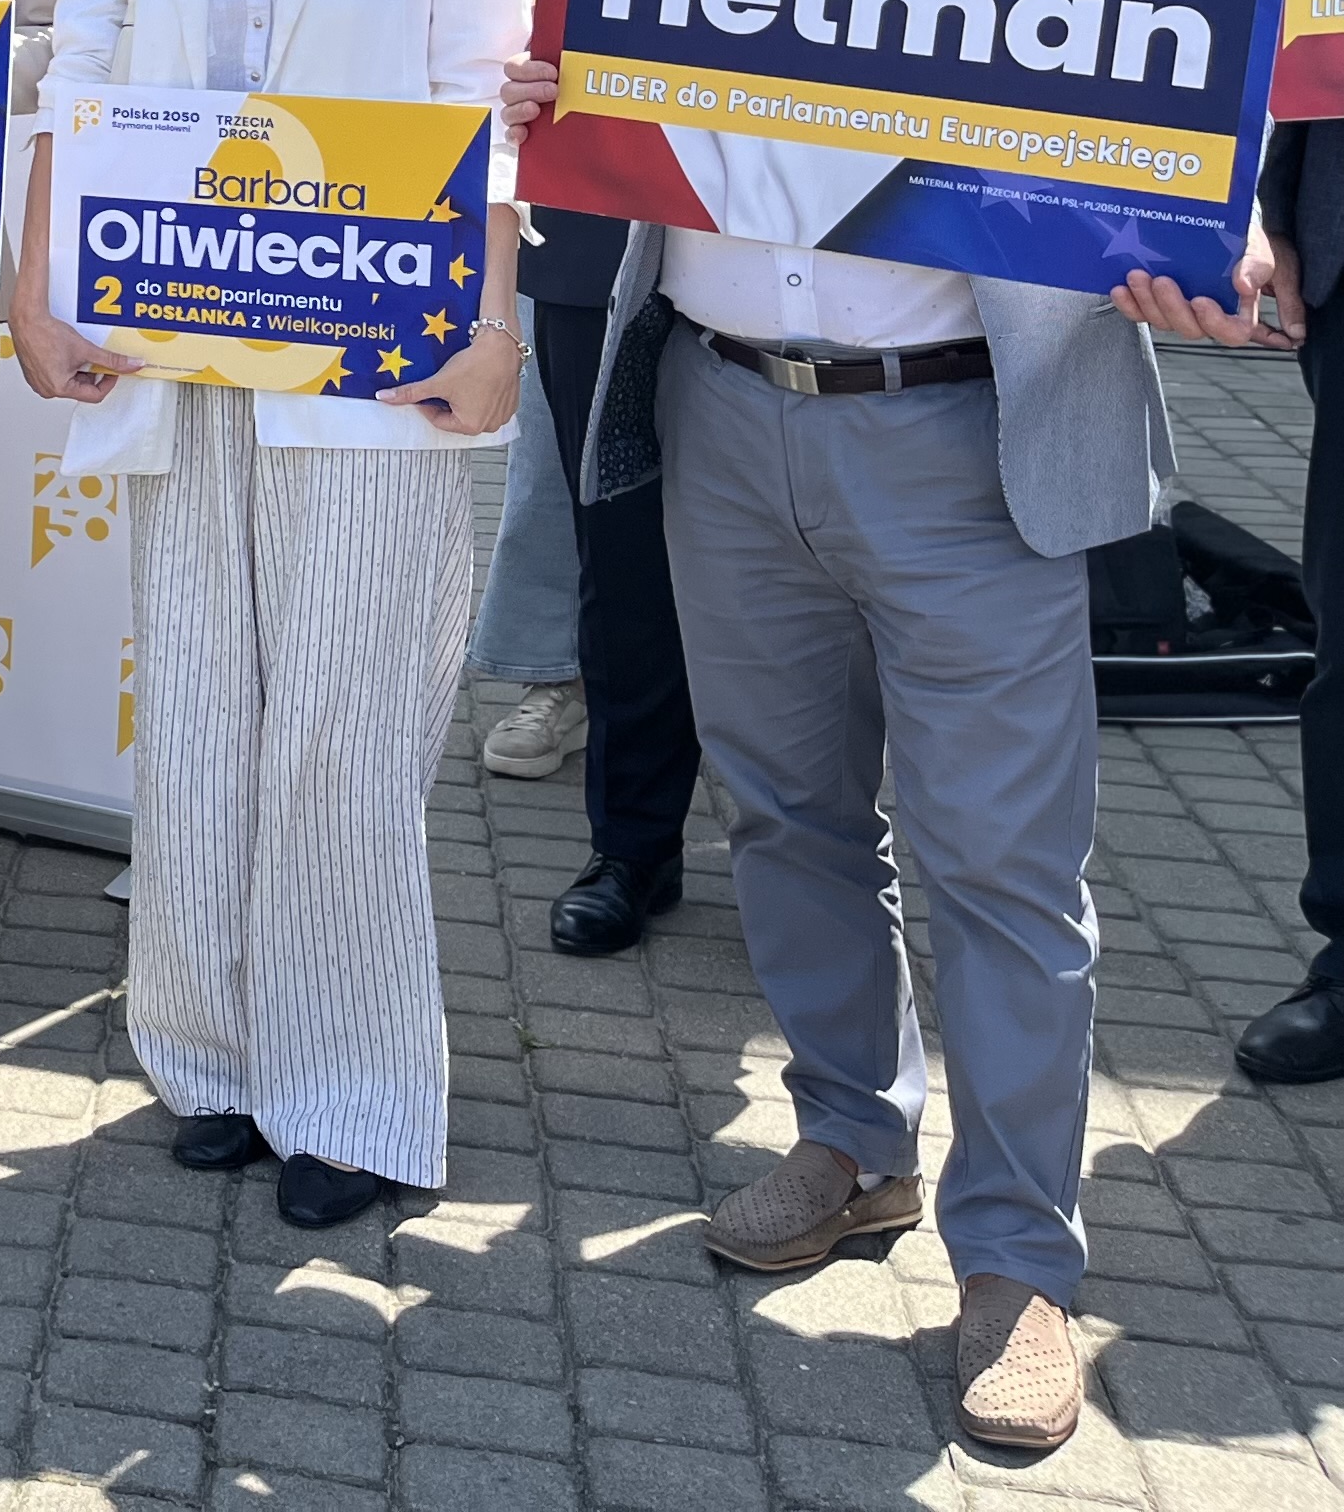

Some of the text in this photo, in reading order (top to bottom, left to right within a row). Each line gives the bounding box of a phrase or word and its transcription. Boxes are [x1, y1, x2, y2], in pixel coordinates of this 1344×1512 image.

[112, 107, 200, 123] Polska 2050
[216, 115, 274, 128] TRZECIA
[219, 128, 270, 141] DROGA
[586, 70, 1203, 183] LIDER do Parlamentu Europejskiego
[195, 167, 366, 211] Barbara
[909, 175, 1225, 229] MATERIAŁ KKW TRZECIA DROGA PSL-PL2050 SZYMONA HOŁOWNI
[86, 207, 433, 287] Oliwiecka
[92, 275, 123, 316] 2
[135, 279, 343, 314] do EUROparlamentu
[134, 301, 395, 342] POSŁANKA z Wielkopolski
